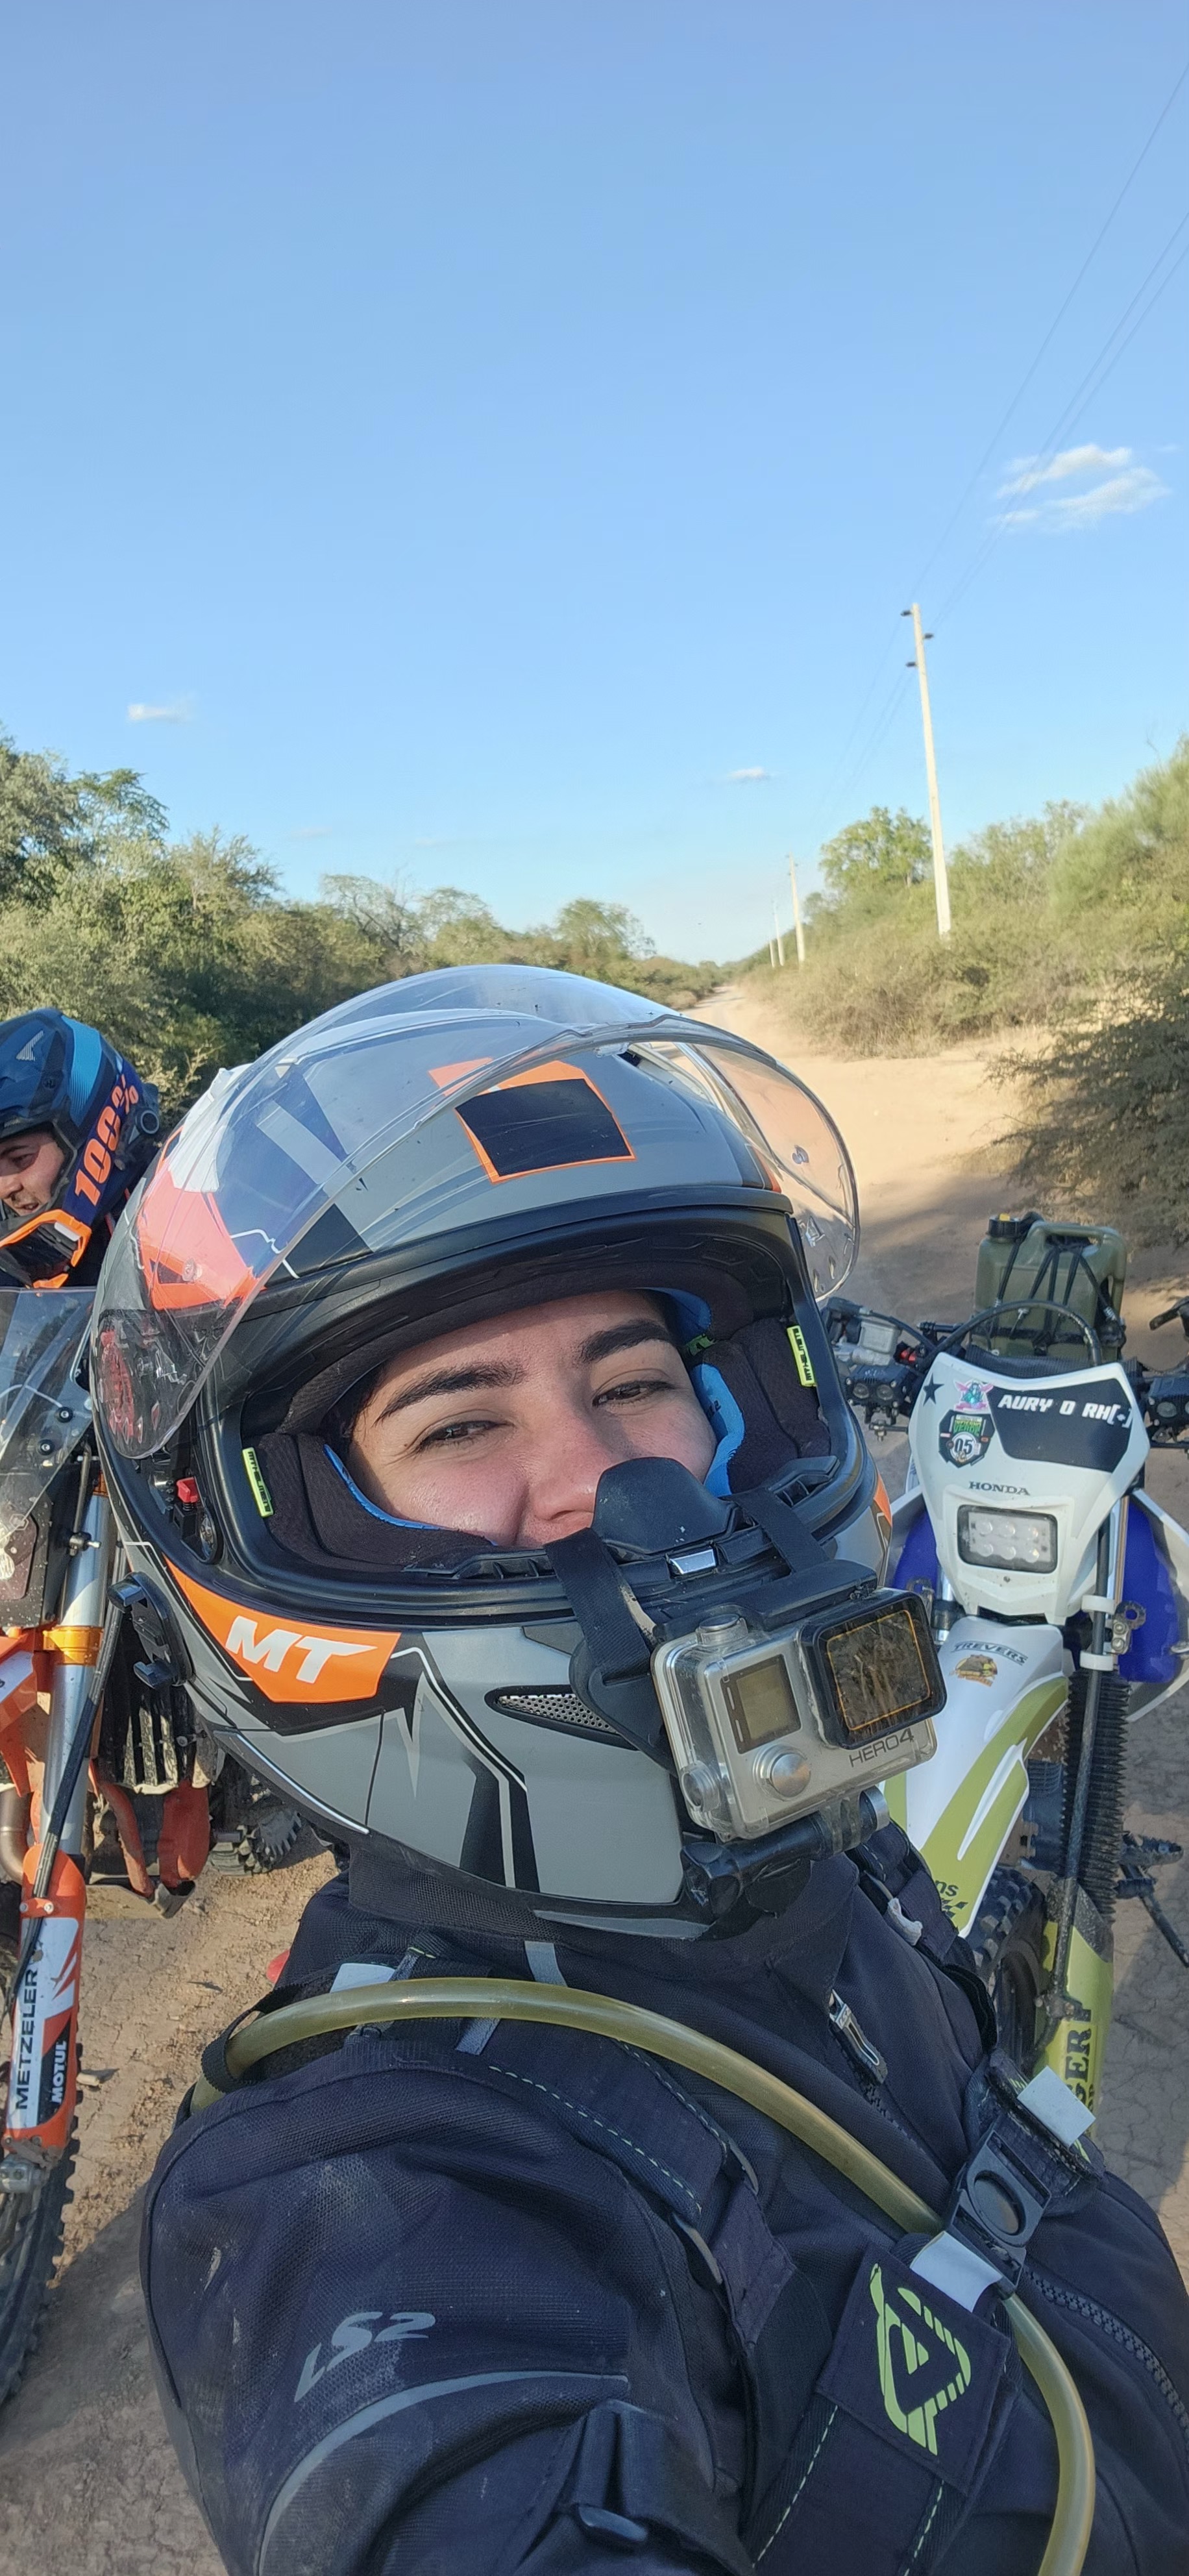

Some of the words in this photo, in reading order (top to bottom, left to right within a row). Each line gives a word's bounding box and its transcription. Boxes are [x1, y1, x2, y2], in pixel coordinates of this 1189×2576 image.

[75, 1074, 139, 1206] 100%
[998, 1394, 1053, 1412] AURY
[955, 1439, 972, 1455] 05
[969, 1481, 1030, 1496] HONDA
[226, 1615, 378, 1683] MT
[849, 1728, 914, 1767] HERO4
[16, 1968, 38, 2110] METZELER
[51, 2040, 67, 2104] MOTUL
[294, 2312, 435, 2402] LS2
